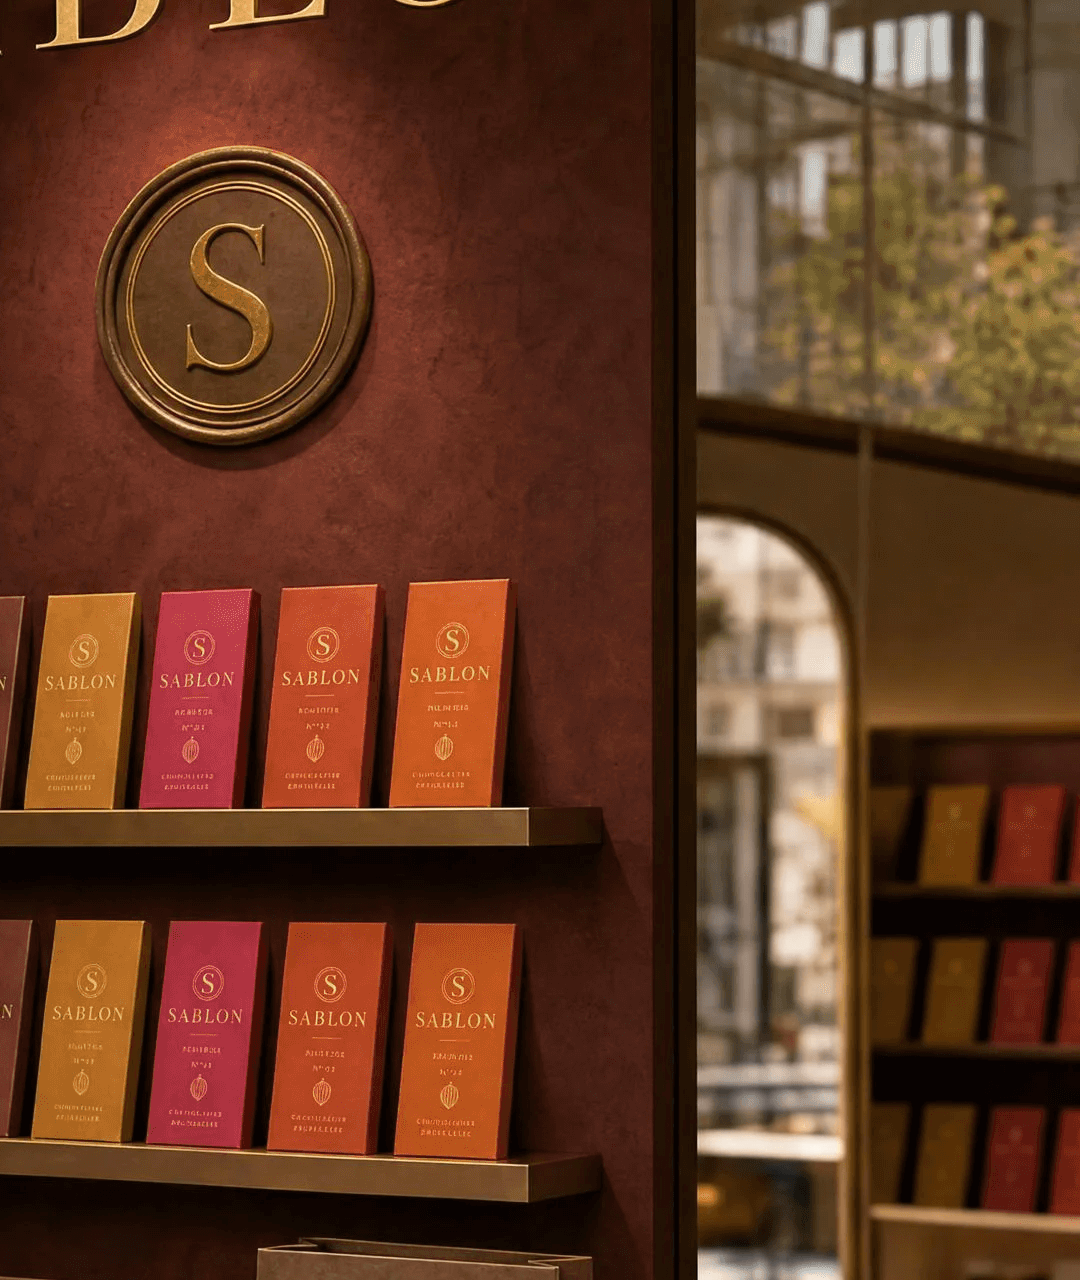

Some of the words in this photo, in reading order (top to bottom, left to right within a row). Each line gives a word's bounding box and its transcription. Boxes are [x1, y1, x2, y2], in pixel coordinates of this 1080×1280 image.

[185, 222, 274, 373] S
[45, 674, 117, 691] SABLON
[159, 672, 234, 689] SABLON
[282, 668, 360, 687] SABLON
[409, 665, 491, 683] SABLON
[52, 1005, 125, 1021] SABLON
[168, 1007, 243, 1024] SABLON
[288, 1009, 367, 1027] SABLON
[415, 1011, 497, 1029] SABLON
